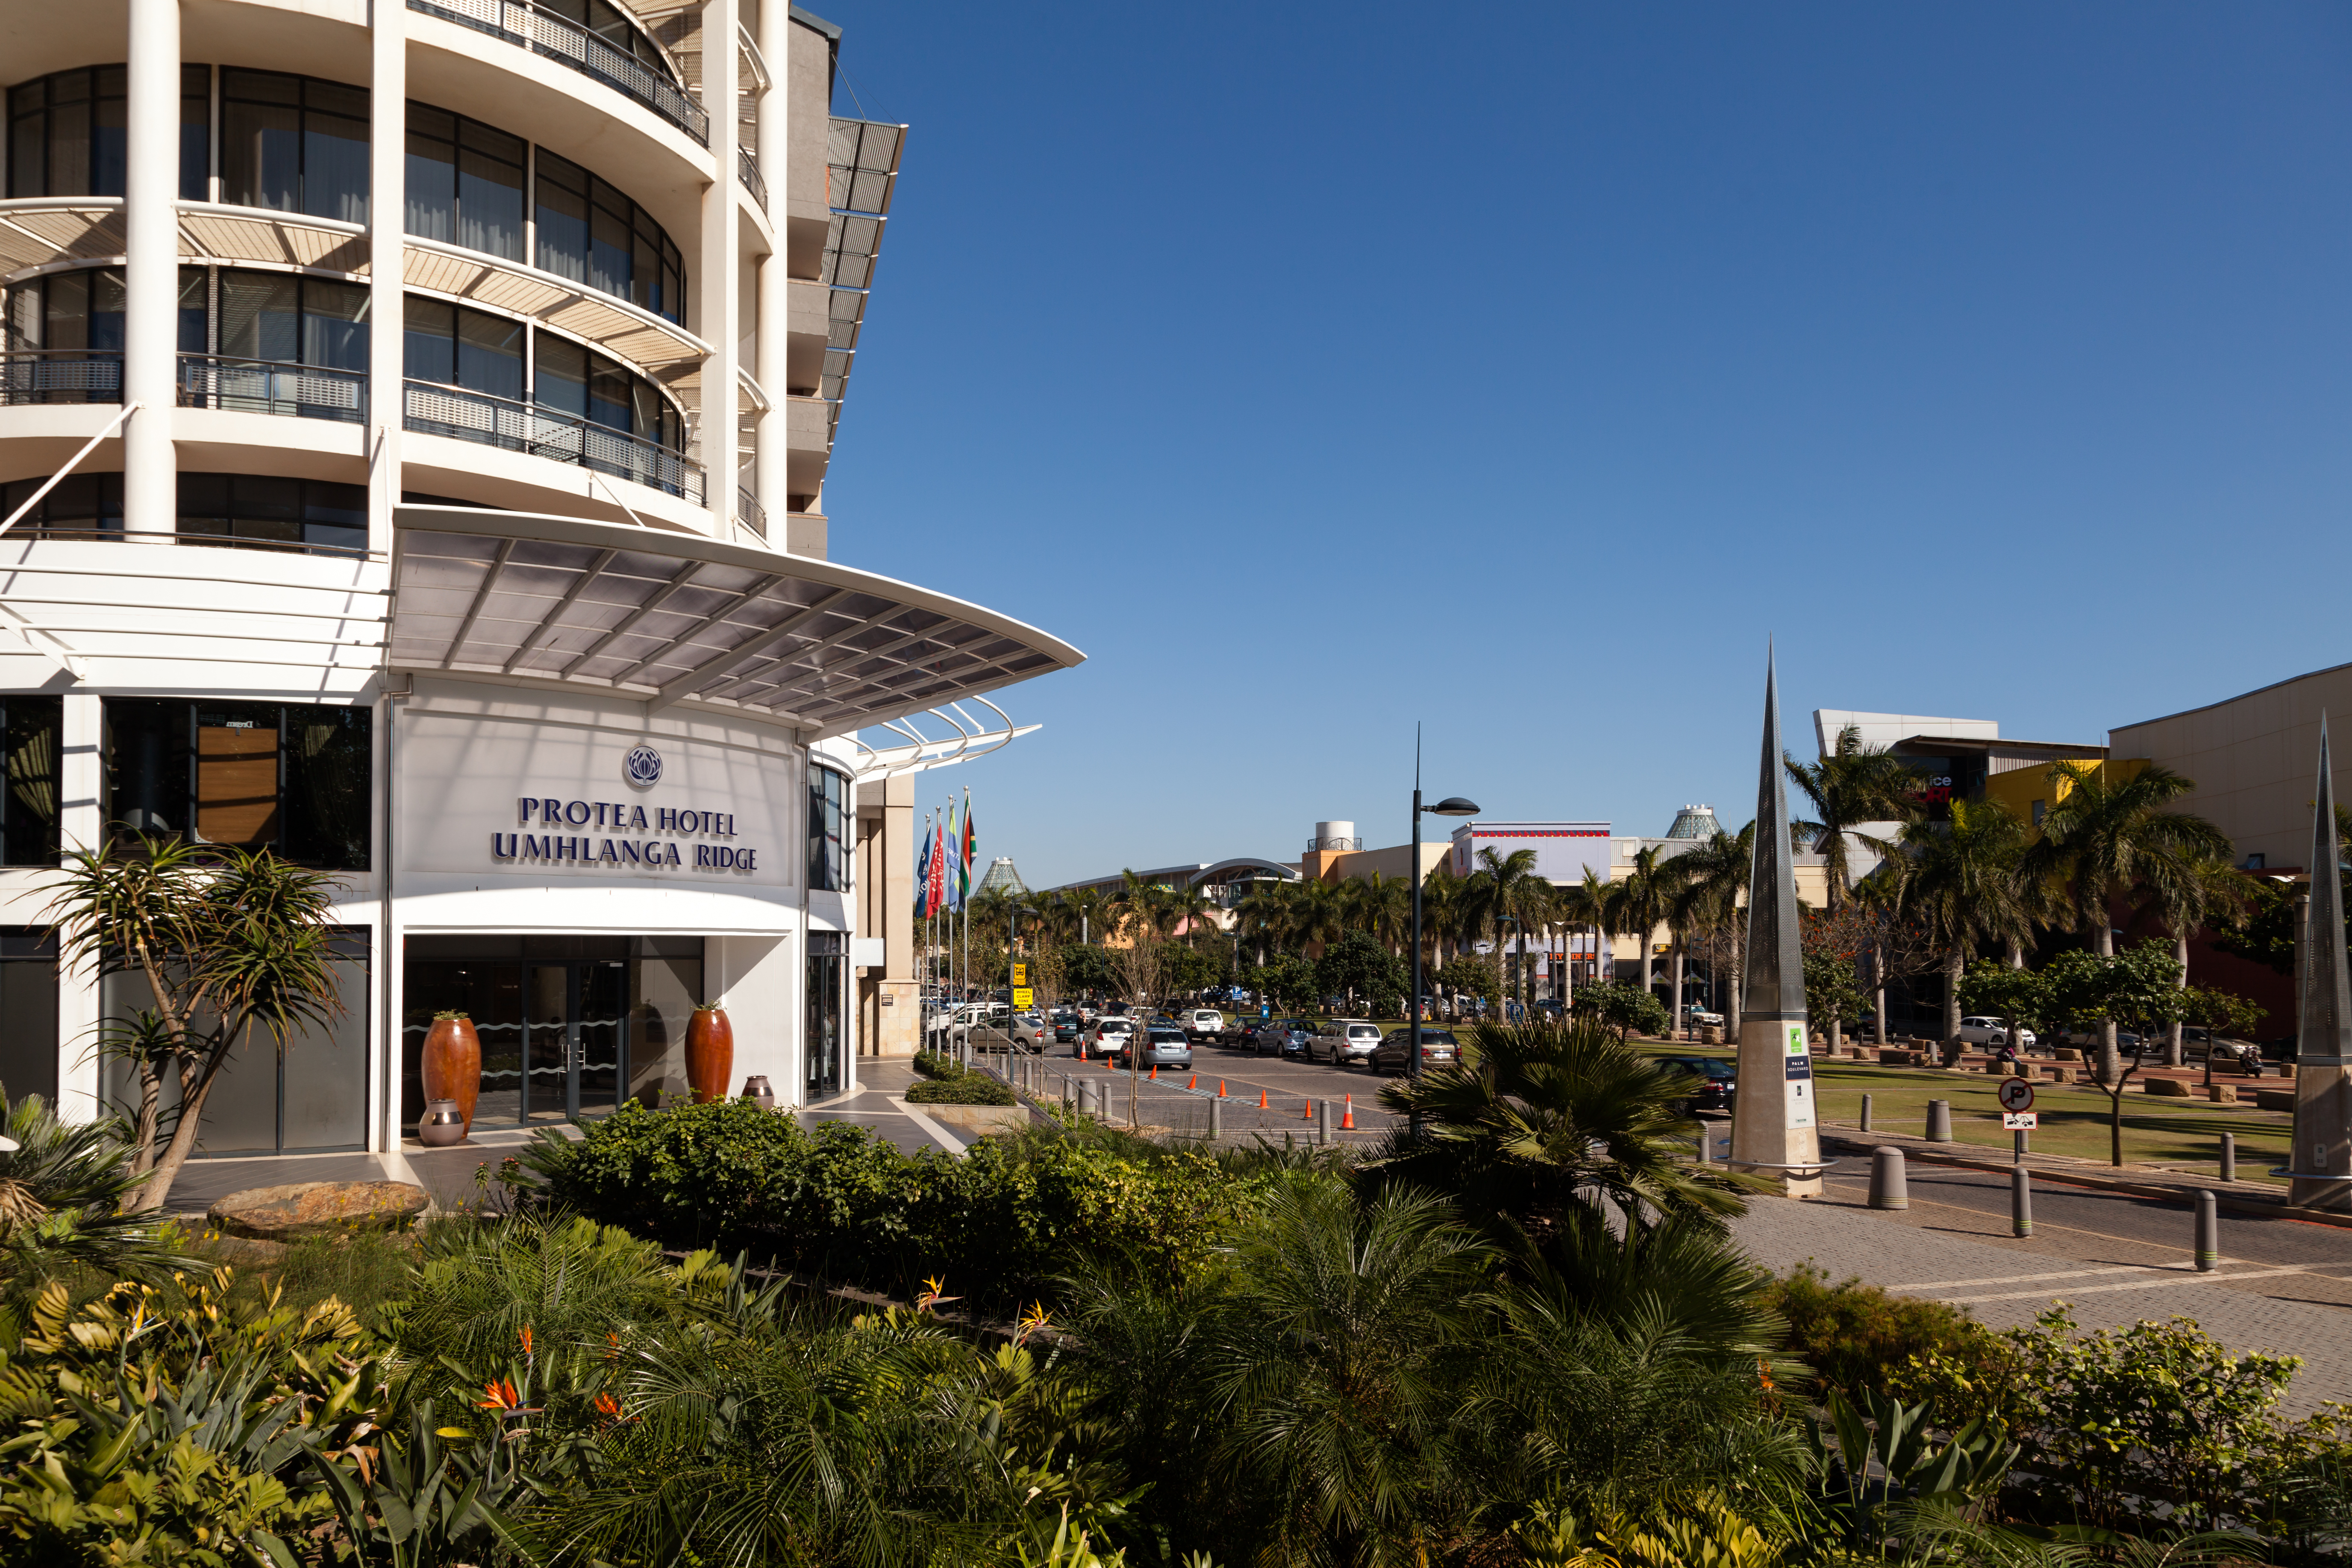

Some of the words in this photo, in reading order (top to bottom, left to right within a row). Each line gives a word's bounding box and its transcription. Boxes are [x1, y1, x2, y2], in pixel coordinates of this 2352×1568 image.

[519, 797, 648, 829] PROTEA
[657, 807, 738, 836] HOTEL
[493, 832, 681, 866] UMHLANGA
[694, 844, 758, 871] RIDGE
[948, 847, 959, 861] BRIT
[2011, 1086, 2026, 1104] P
